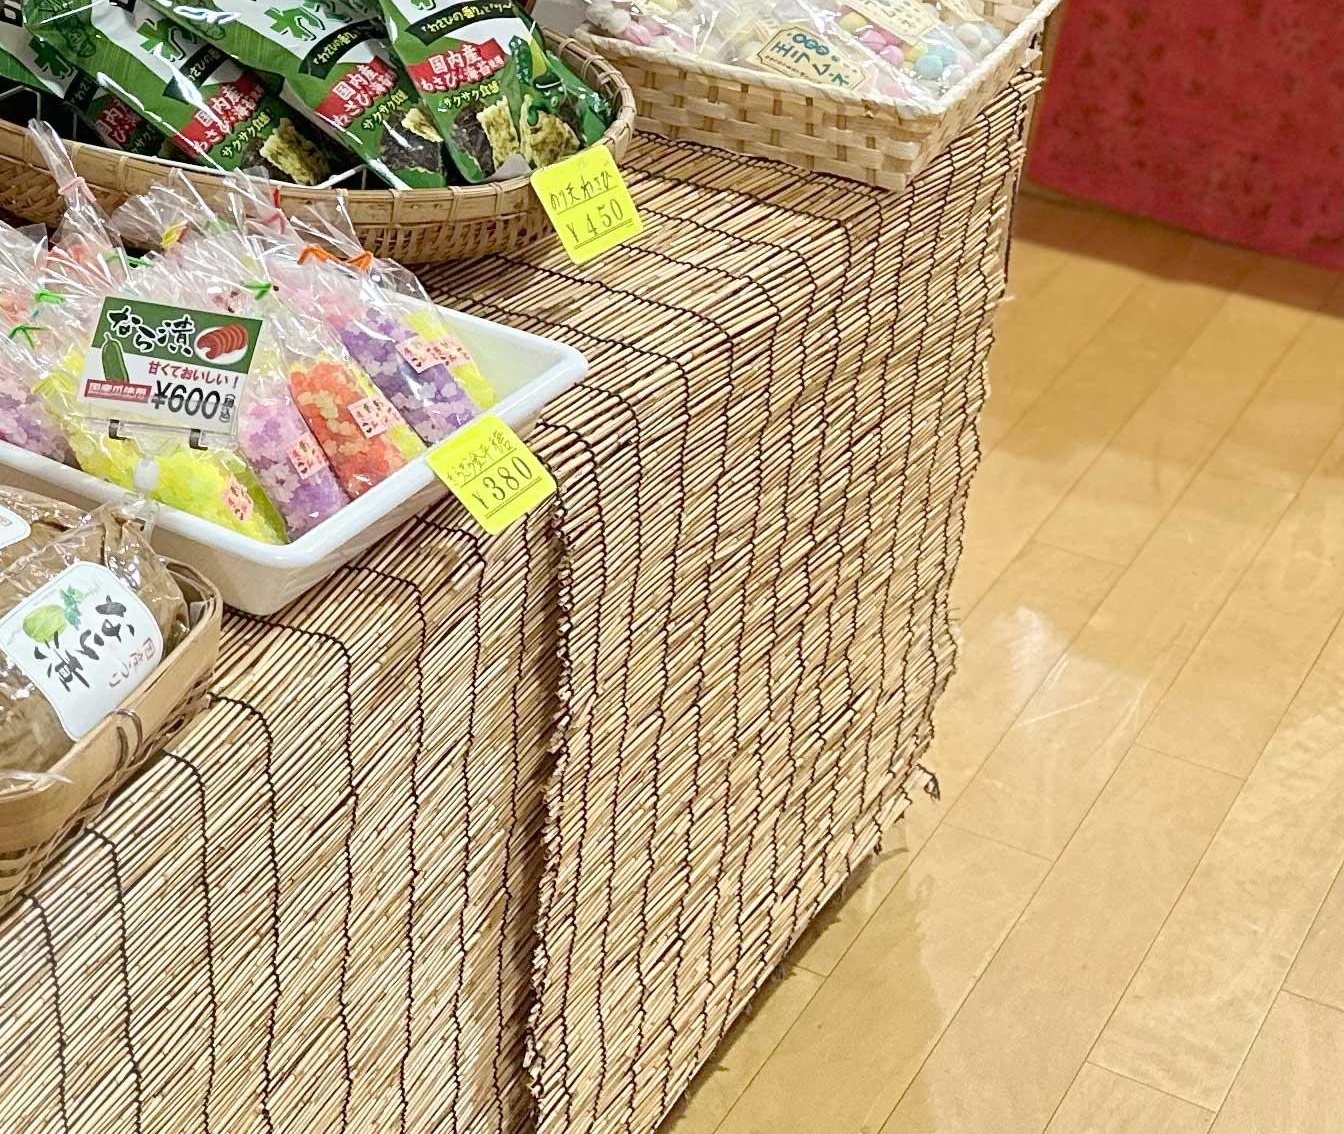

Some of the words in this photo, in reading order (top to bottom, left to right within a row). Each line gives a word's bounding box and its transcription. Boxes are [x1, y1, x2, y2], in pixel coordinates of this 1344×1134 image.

[426, 43, 483, 74] 国内産
[566, 198, 624, 244] ¥450
[107, 305, 196, 358] なら漬
[151, 379, 221, 420] ¥600
[473, 455, 534, 510] ¥380
[33, 594, 136, 693] なら漬
